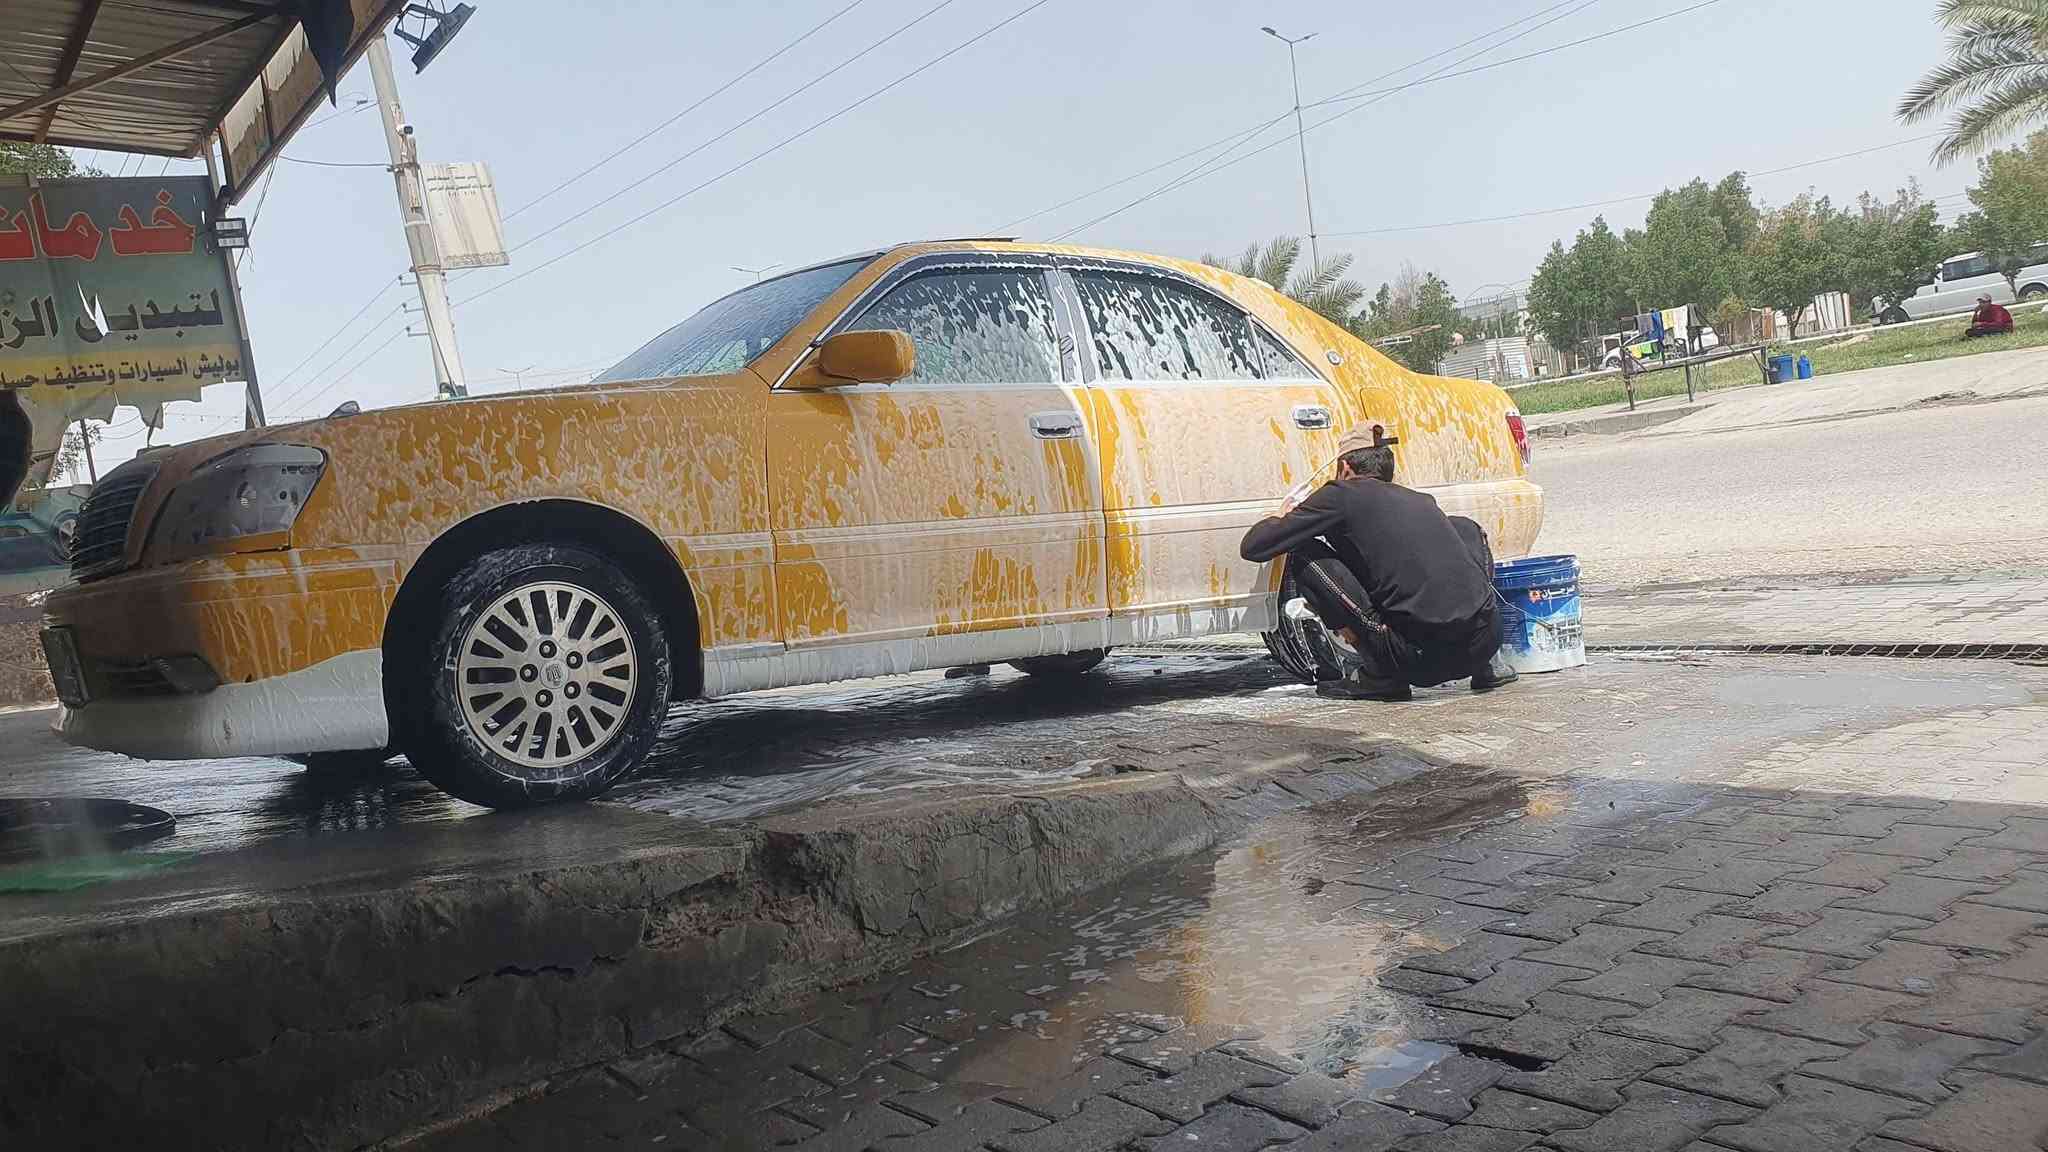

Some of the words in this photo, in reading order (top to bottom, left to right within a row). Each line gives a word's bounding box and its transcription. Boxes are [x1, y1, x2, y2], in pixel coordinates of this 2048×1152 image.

[75, 288, 223, 343] لتبديل
[45, 363, 116, 389] وتنظيف
[119, 356, 188, 382] السيارات
[193, 353, 240, 379] بوليش
